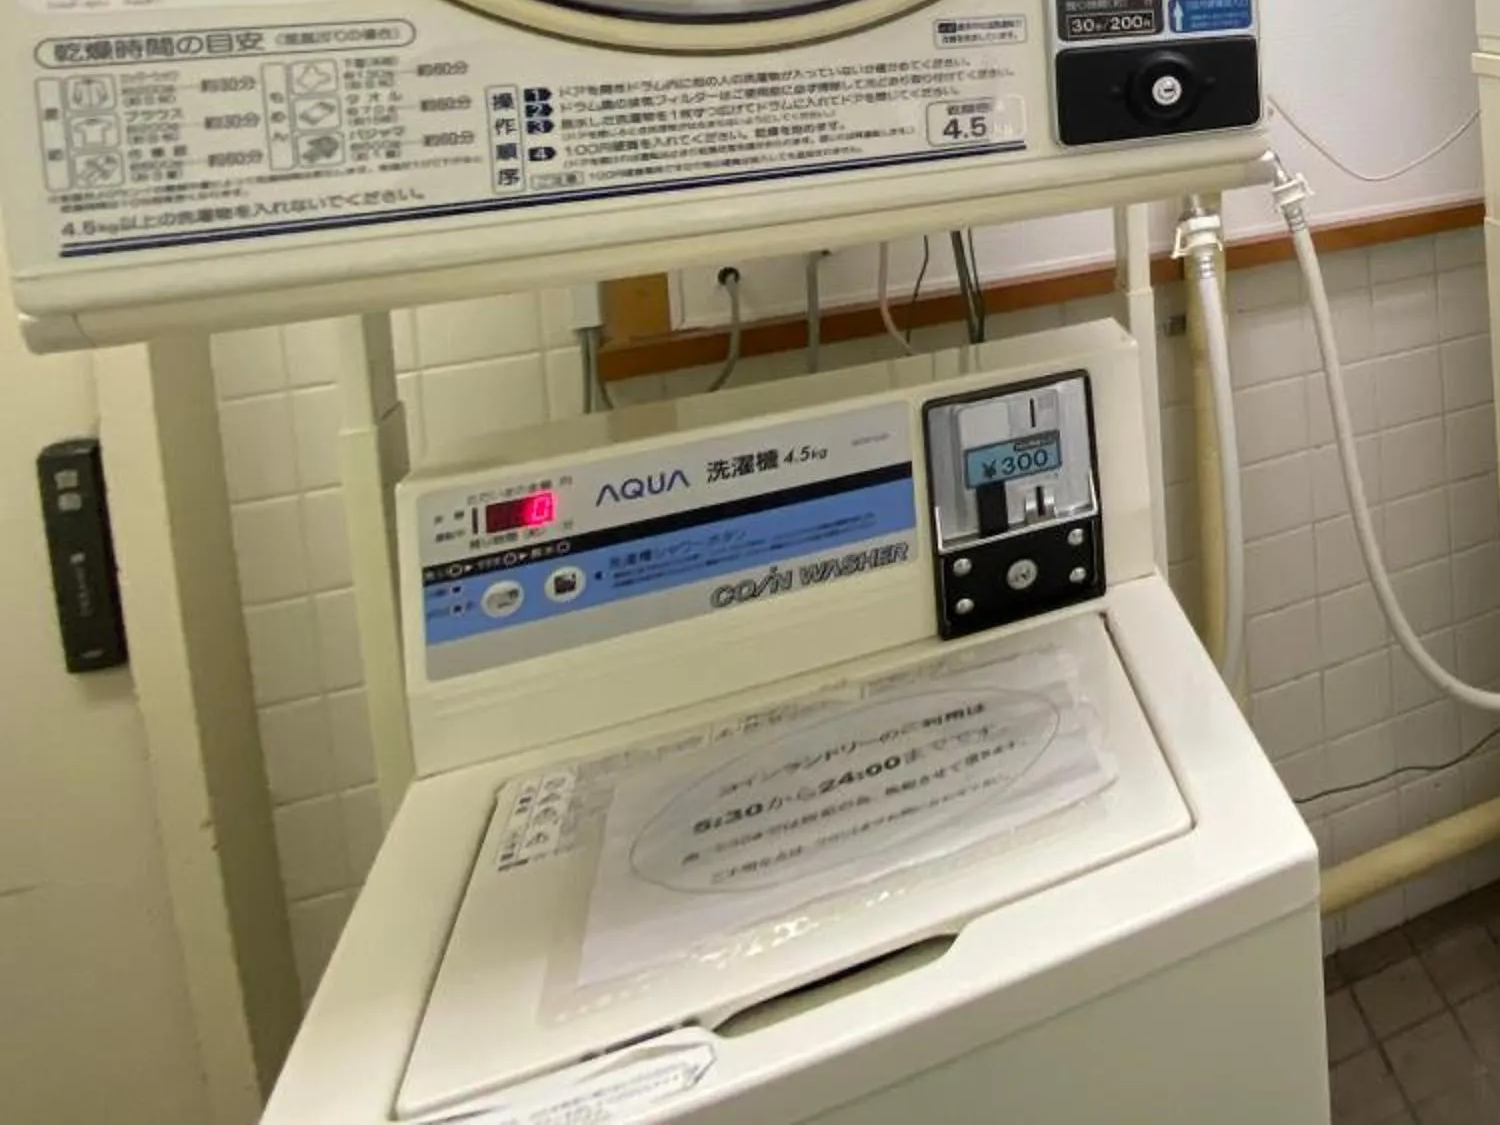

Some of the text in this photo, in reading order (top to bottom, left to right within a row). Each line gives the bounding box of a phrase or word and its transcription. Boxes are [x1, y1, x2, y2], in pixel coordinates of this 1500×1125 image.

[706, 449, 780, 482] 洗濯機
[982, 447, 1050, 480] ¥300
[595, 469, 690, 507] AQUA
[533, 495, 550, 521] 0
[800, 542, 909, 587] WASHER
